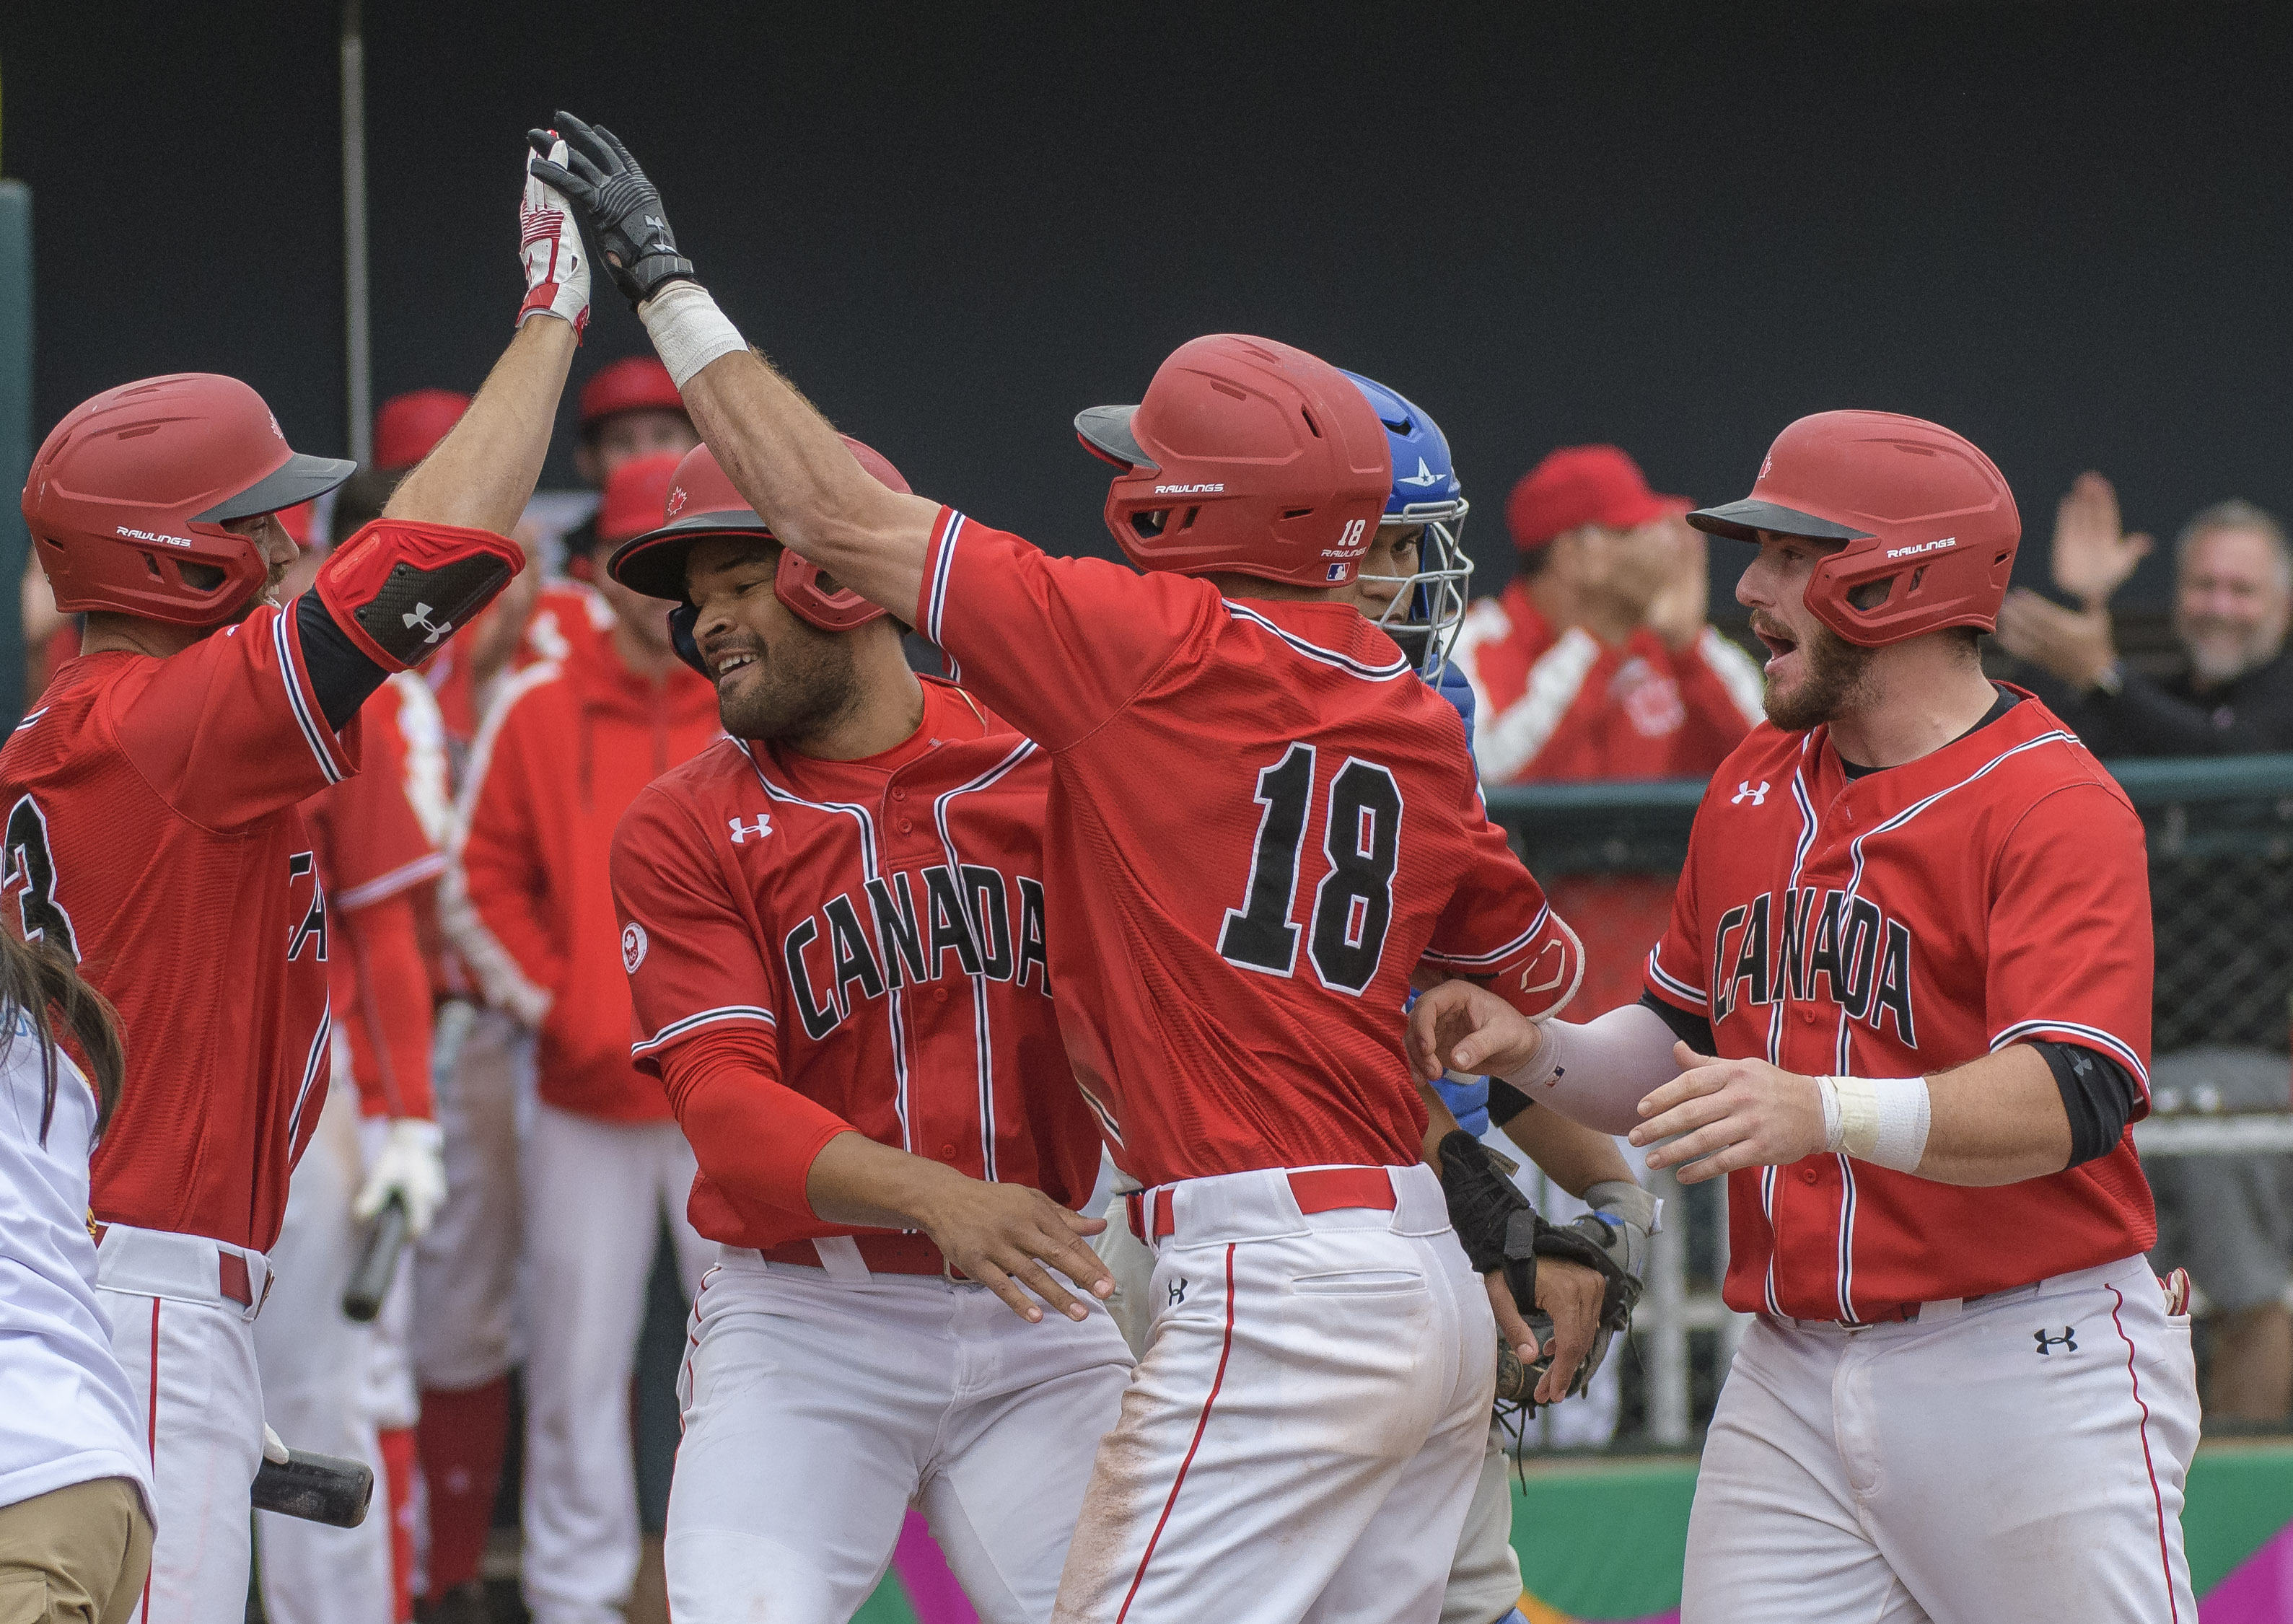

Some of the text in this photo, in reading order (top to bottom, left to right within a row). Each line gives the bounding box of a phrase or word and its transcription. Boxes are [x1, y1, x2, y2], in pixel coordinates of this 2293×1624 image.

[1155, 483, 1224, 494] RAWLINGS
[116, 526, 193, 548] RAWLINGS
[1337, 519, 1366, 546] 18
[1886, 536, 1957, 558] RAWLINGS
[1216, 741, 1404, 998] 18
[784, 863, 1054, 1040] CANADA
[1712, 886, 1919, 1050] CANADA
